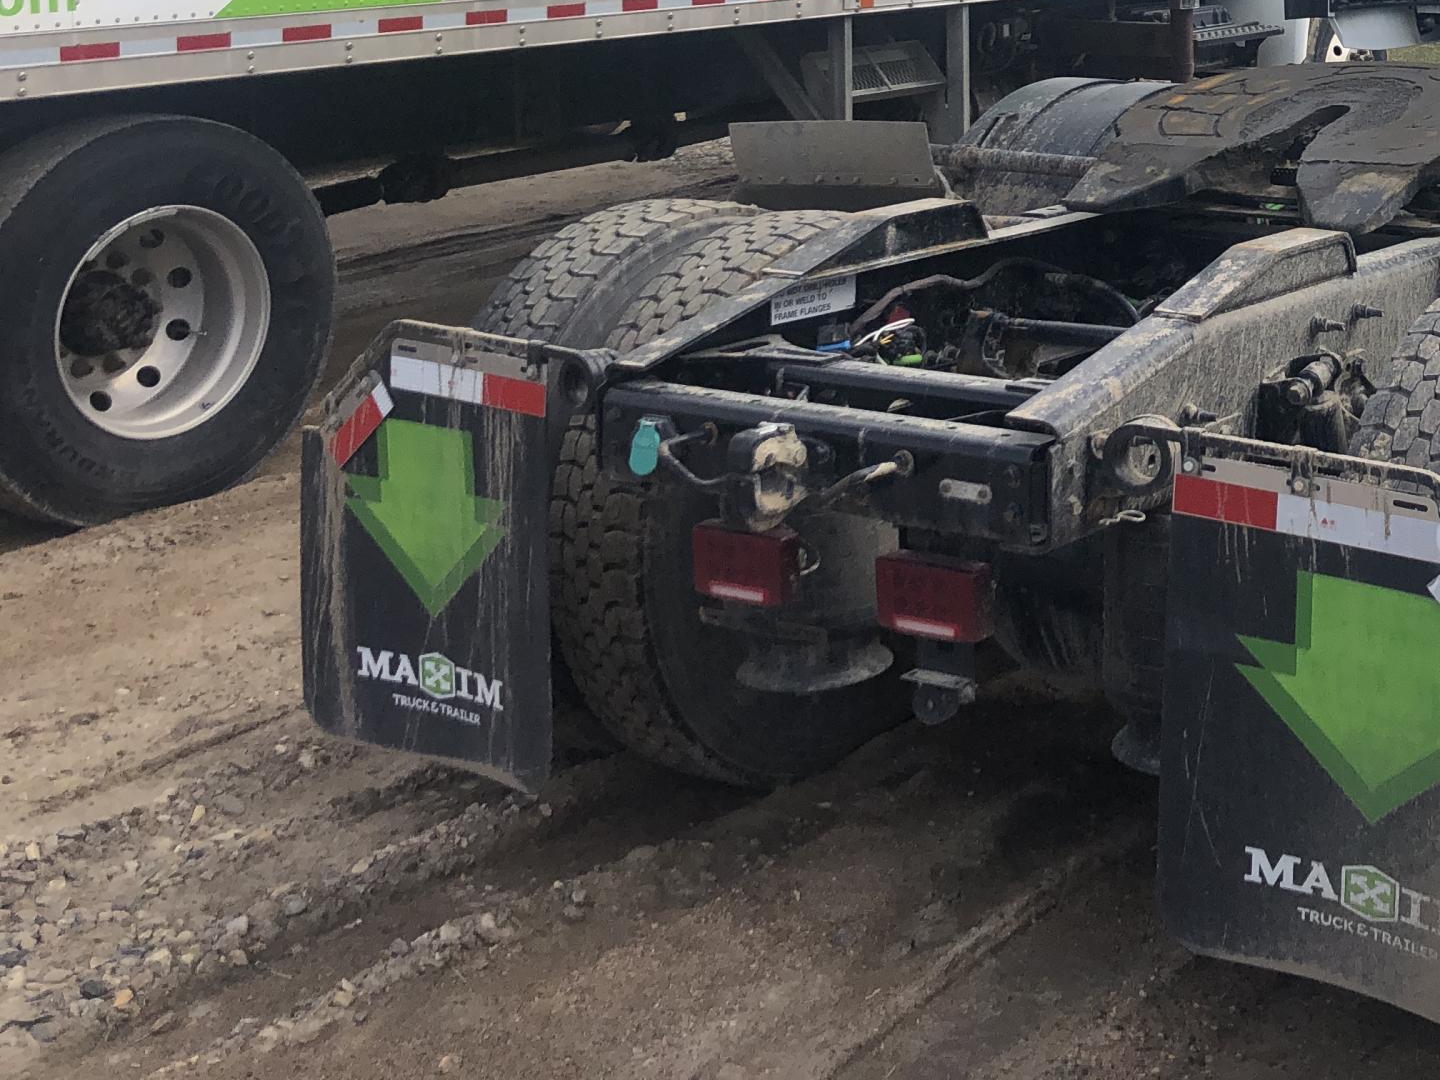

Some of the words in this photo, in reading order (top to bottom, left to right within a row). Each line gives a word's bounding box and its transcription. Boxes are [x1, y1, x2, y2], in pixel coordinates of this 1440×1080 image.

[773, 309, 799, 321] FRAME
[800, 303, 832, 316] FLANGES
[783, 299, 794, 307] OR
[795, 294, 815, 305] WELD
[816, 292, 827, 301] TO
[356, 645, 504, 711] MAXIM
[392, 693, 430, 711] TRUCK
[439, 702, 481, 726] TRAILER
[1296, 906, 1354, 935] TRUCK
[1369, 926, 1438, 961] TRAILER
